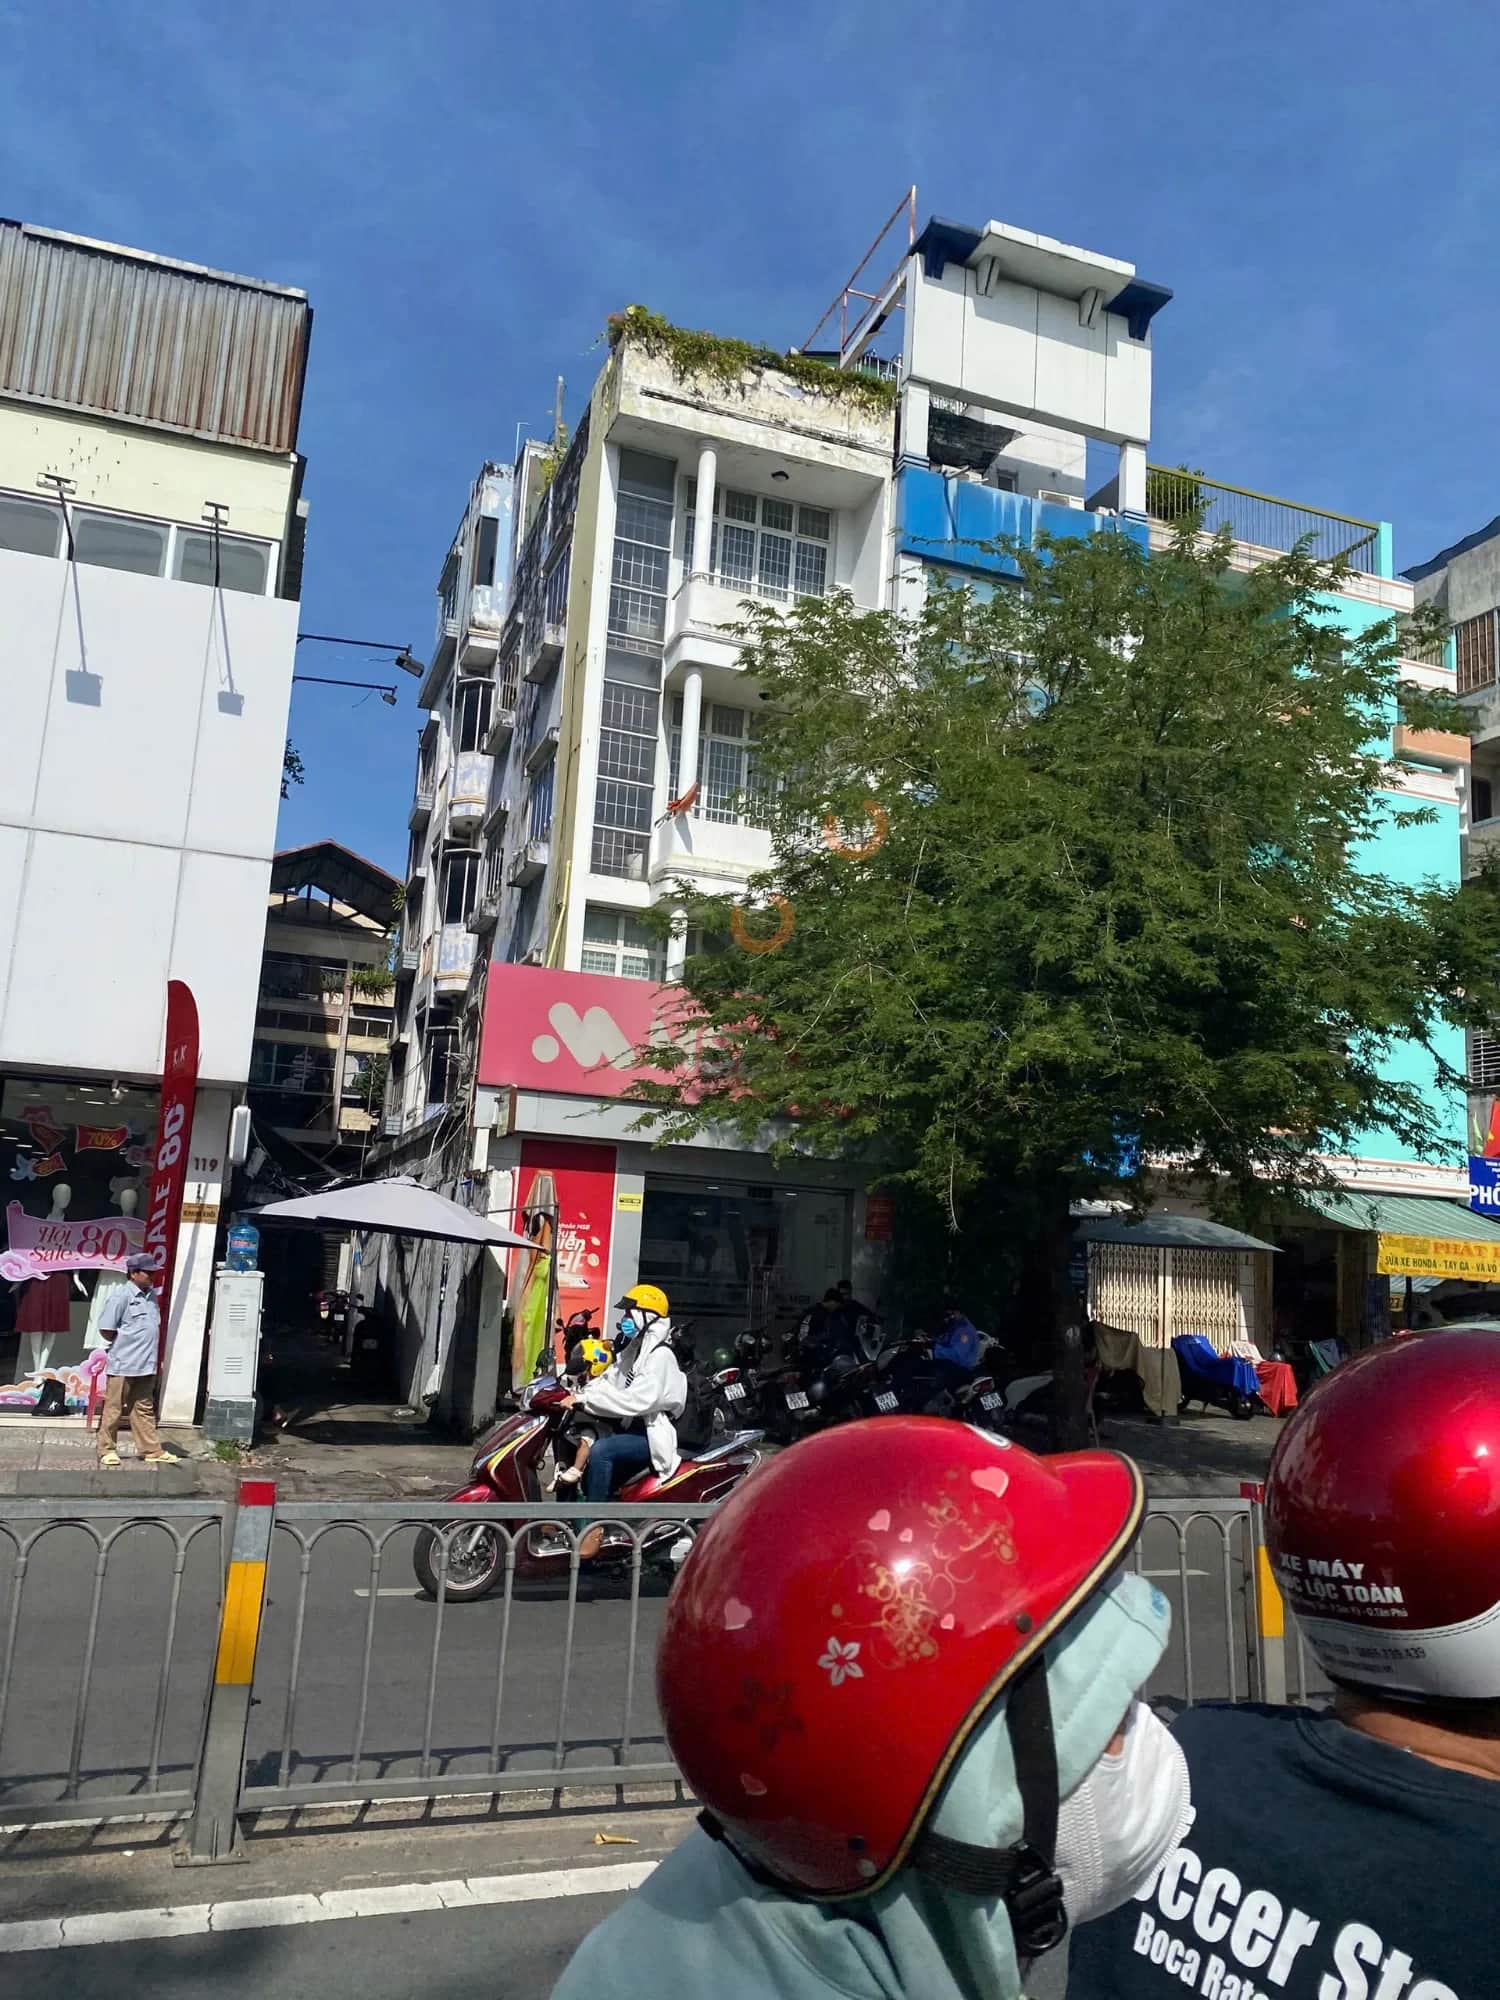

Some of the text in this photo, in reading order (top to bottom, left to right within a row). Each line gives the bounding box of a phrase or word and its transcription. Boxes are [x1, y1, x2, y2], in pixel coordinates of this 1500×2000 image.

[193, 1156, 219, 1172] 119
[77, 1224, 129, 1261] 80
[1412, 1257, 1438, 1269] HONDA
[1444, 1260, 1458, 1270] TAY
[1279, 1552, 1365, 1580] XE MÁY
[1305, 1577, 1340, 1601] LỘC
[1342, 1582, 1404, 1604] TOÀN
[1132, 1911, 1271, 2000] Boca Rat
[1318, 1922, 1461, 2000] St
